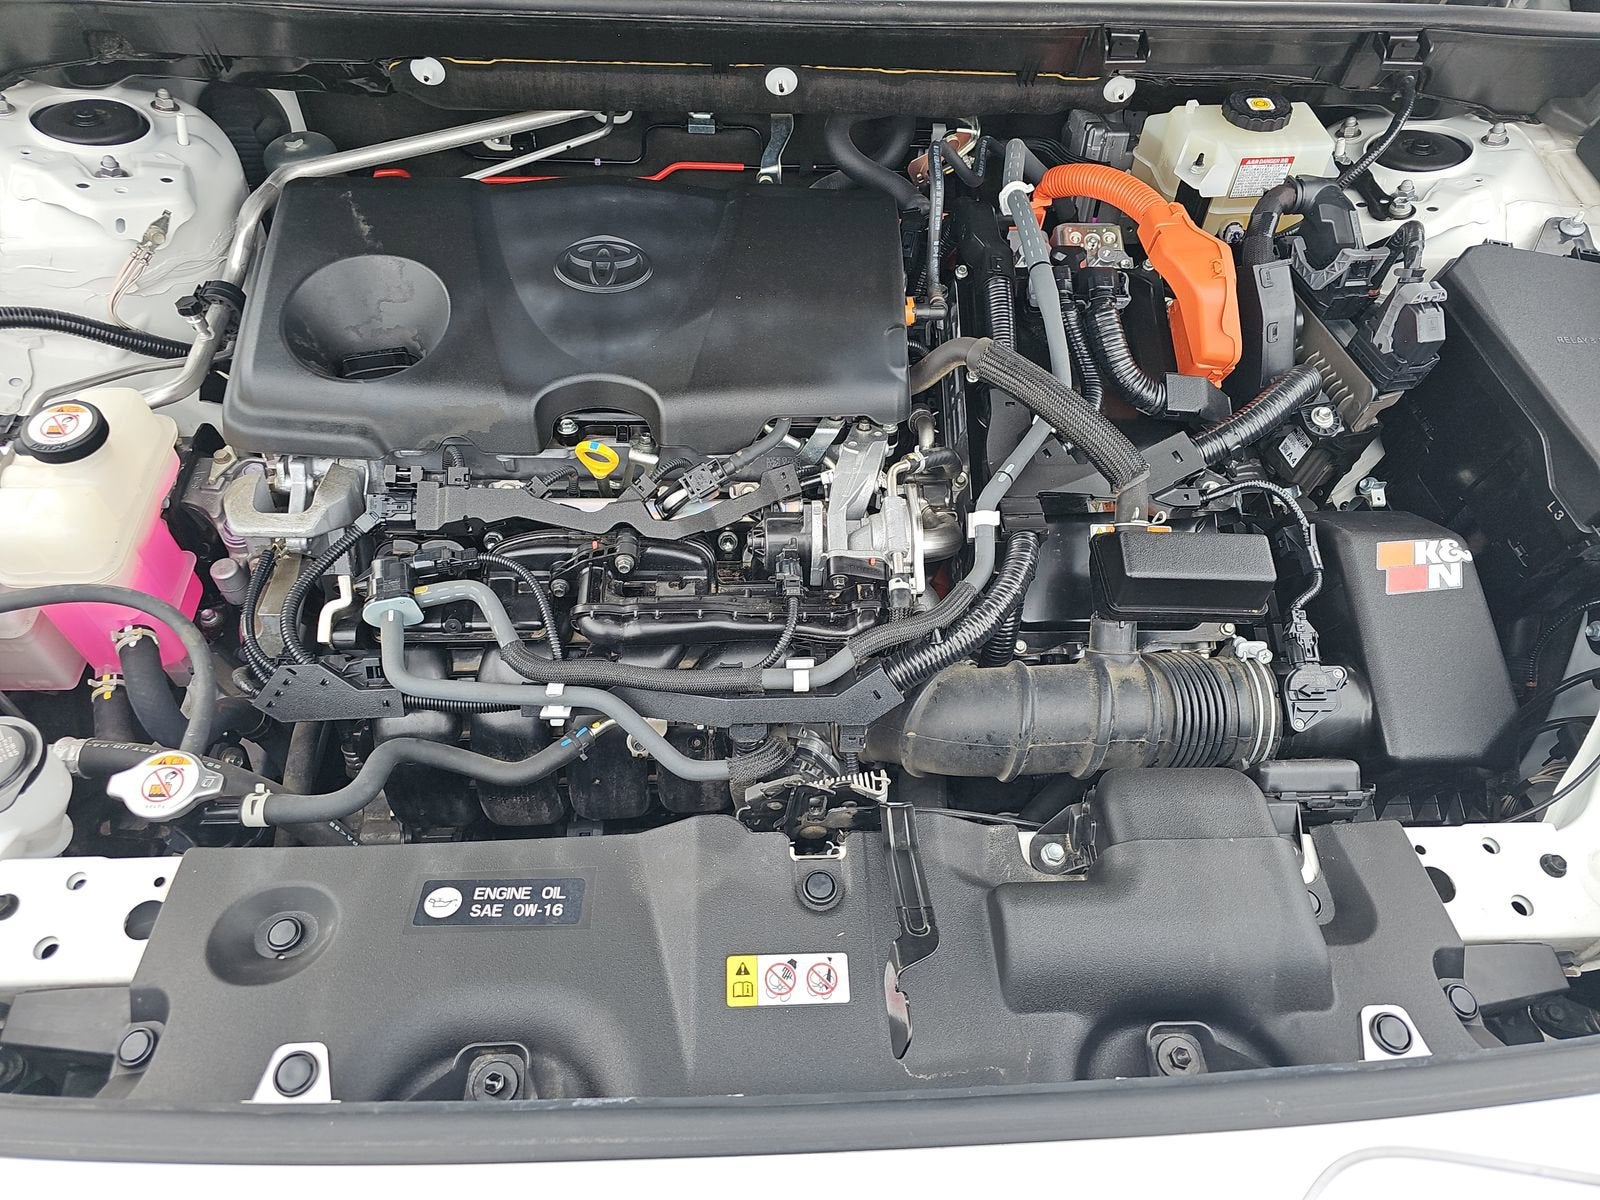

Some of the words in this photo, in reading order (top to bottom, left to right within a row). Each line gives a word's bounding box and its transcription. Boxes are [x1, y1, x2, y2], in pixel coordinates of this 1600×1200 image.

[1556, 336, 1587, 344] RELAY
[1286, 452, 1297, 464] A4
[1547, 501, 1564, 521] L3
[473, 887, 532, 900] ENGINE
[541, 887, 566, 899] OIL
[469, 904, 503, 917] SAE
